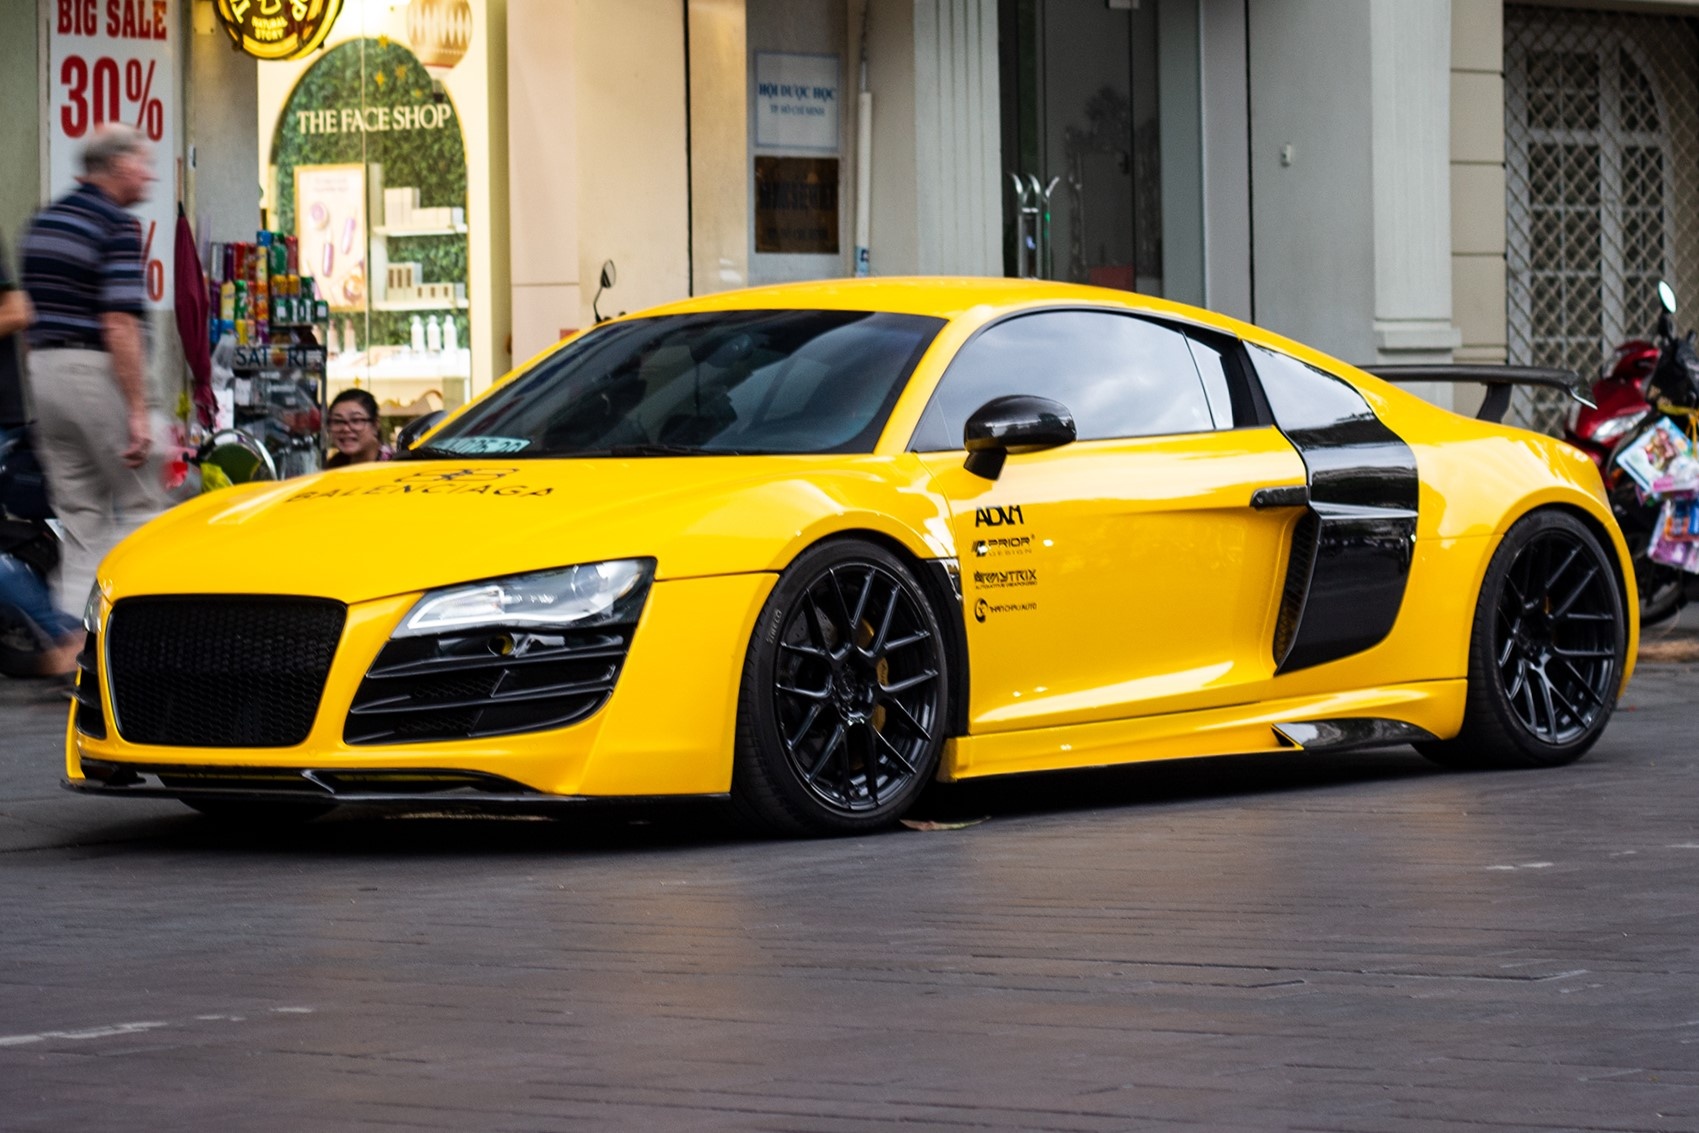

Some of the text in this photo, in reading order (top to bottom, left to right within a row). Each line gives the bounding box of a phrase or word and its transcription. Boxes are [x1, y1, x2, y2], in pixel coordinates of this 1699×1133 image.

[57, 0, 167, 41] BIG SALE
[251, 15, 289, 29] NATURAL
[255, 28, 284, 41] STORY
[61, 54, 164, 142] 30%
[297, 103, 451, 134] THE FACE SHOP
[284, 483, 554, 503] BALENCIAGA
